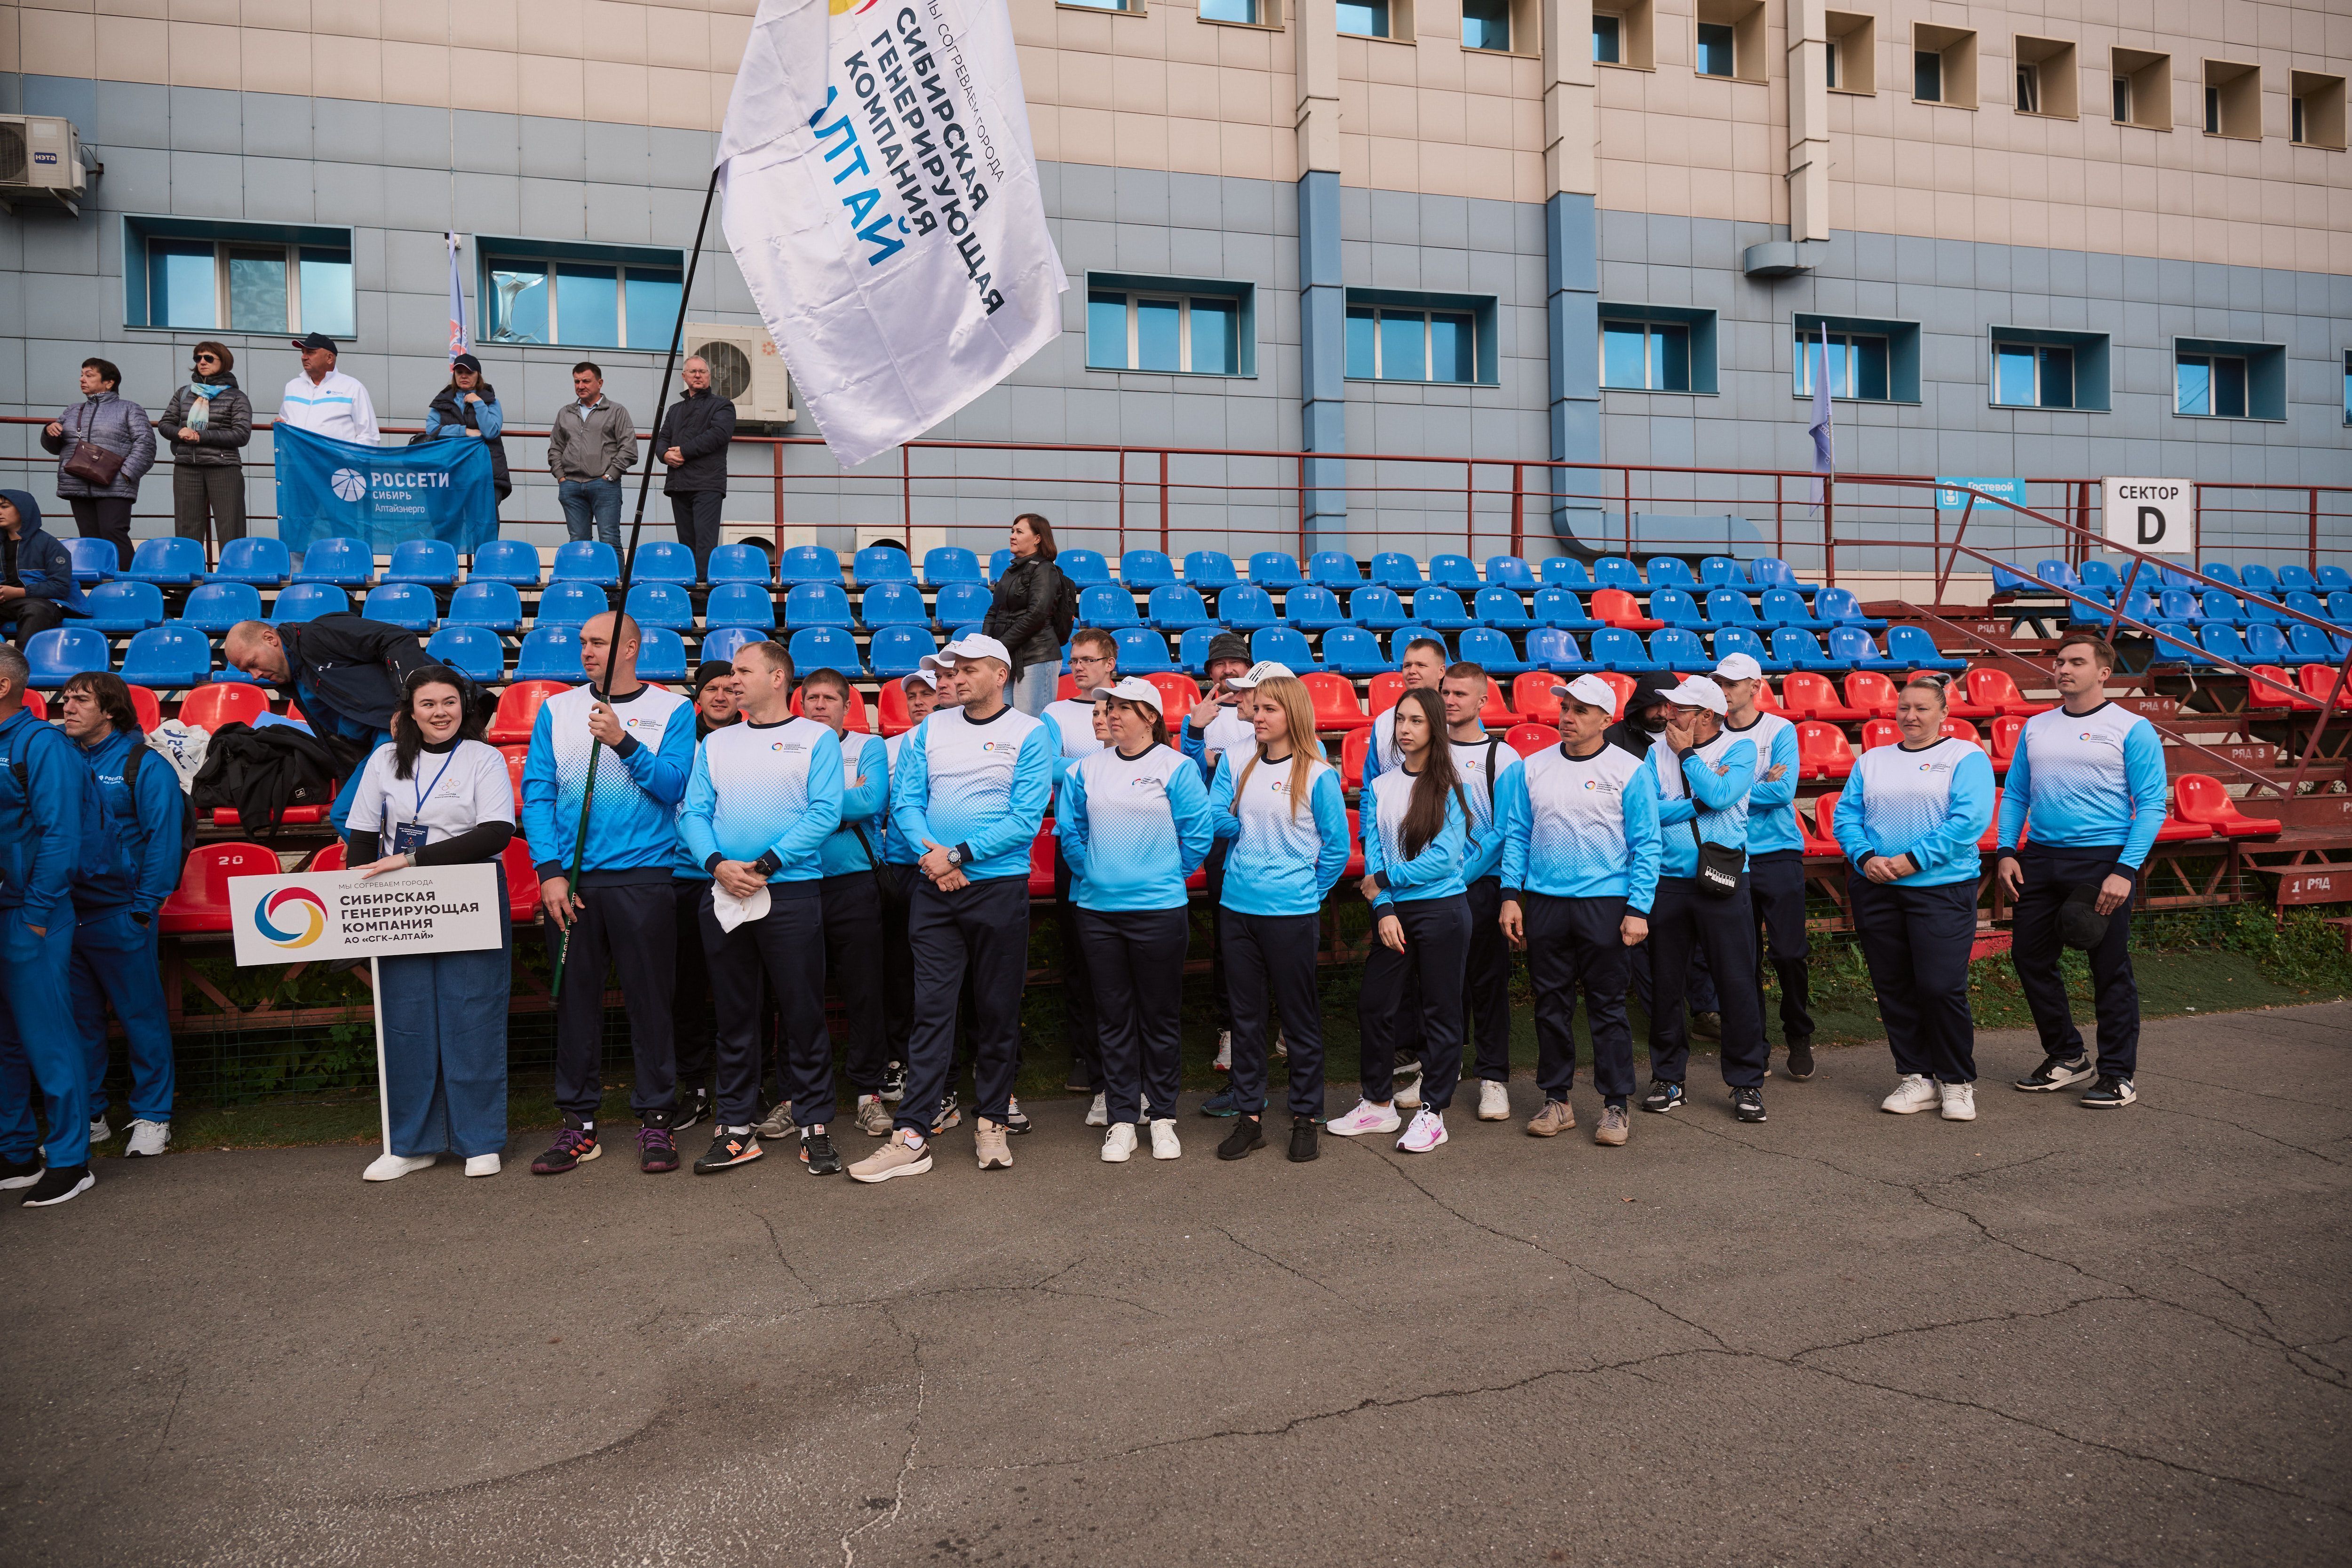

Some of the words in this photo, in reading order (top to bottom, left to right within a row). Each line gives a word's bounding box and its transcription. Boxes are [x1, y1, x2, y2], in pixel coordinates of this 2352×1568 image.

[897, 7, 988, 213] СИБИРСКАЯ
[938, 24, 979, 118] СОГРЕВАЕМ
[975, 117, 1004, 183] ГОРОДА
[844, 49, 938, 237] КОМПАНИЯ
[871, 29, 1005, 316] ГЕНЕРИРУЮЩАЯ
[371, 472, 449, 488] РОССЕТИ
[1968, 482, 2014, 492] Гостевой
[373, 491, 412, 500] СИБИРЬ
[2119, 486, 2179, 500] СЕКТОР
[375, 504, 425, 514] Алтайэнерго
[2137, 506, 2166, 545] D
[1978, 624, 1995, 634] РЯД
[2140, 701, 2159, 712] РЯД
[2163, 700, 2169, 710] 4
[2232, 748, 2252, 760] РЯД
[2258, 748, 2265, 758] 3
[218, 856, 243, 865] 20
[1705, 866, 1736, 888] PUMA
[2292, 881, 2300, 893] 1
[2307, 877, 2330, 890] РЯД
[340, 891, 436, 906] СИБИРСКАЯ
[342, 902, 479, 919] ГЕНЕРИРУЮЩАЯ
[343, 918, 433, 933] КОМПАНИЯ
[363, 931, 434, 942] «СГК-АЛТАЙ»
